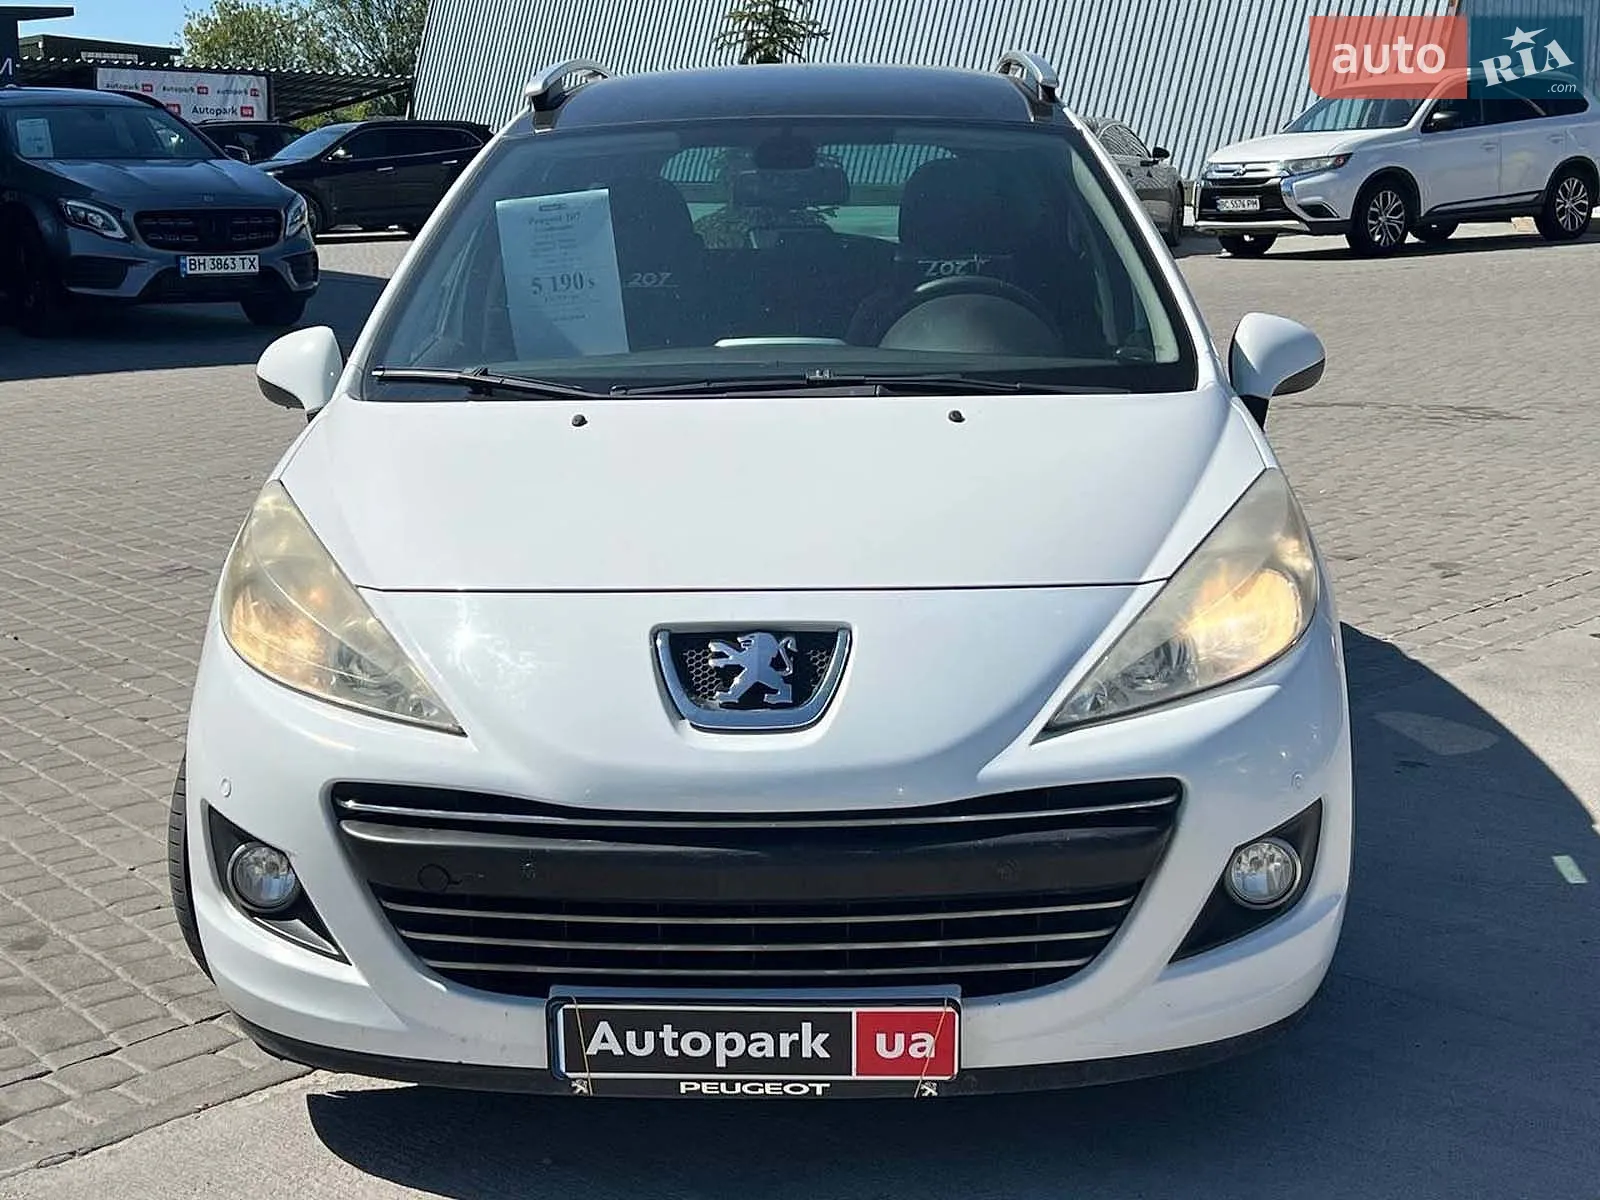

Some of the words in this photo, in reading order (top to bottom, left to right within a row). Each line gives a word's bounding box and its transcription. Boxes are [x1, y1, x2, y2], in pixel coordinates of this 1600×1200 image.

[191, 104, 238, 116] Autopark
[188, 258, 207, 271] BH
[209, 257, 237, 271] 3863
[239, 257, 257, 270] TX
[628, 272, 673, 287] 207
[586, 1020, 831, 1068] Autopark
[875, 1031, 937, 1059] ua
[679, 1081, 831, 1096] PEUGEOT
